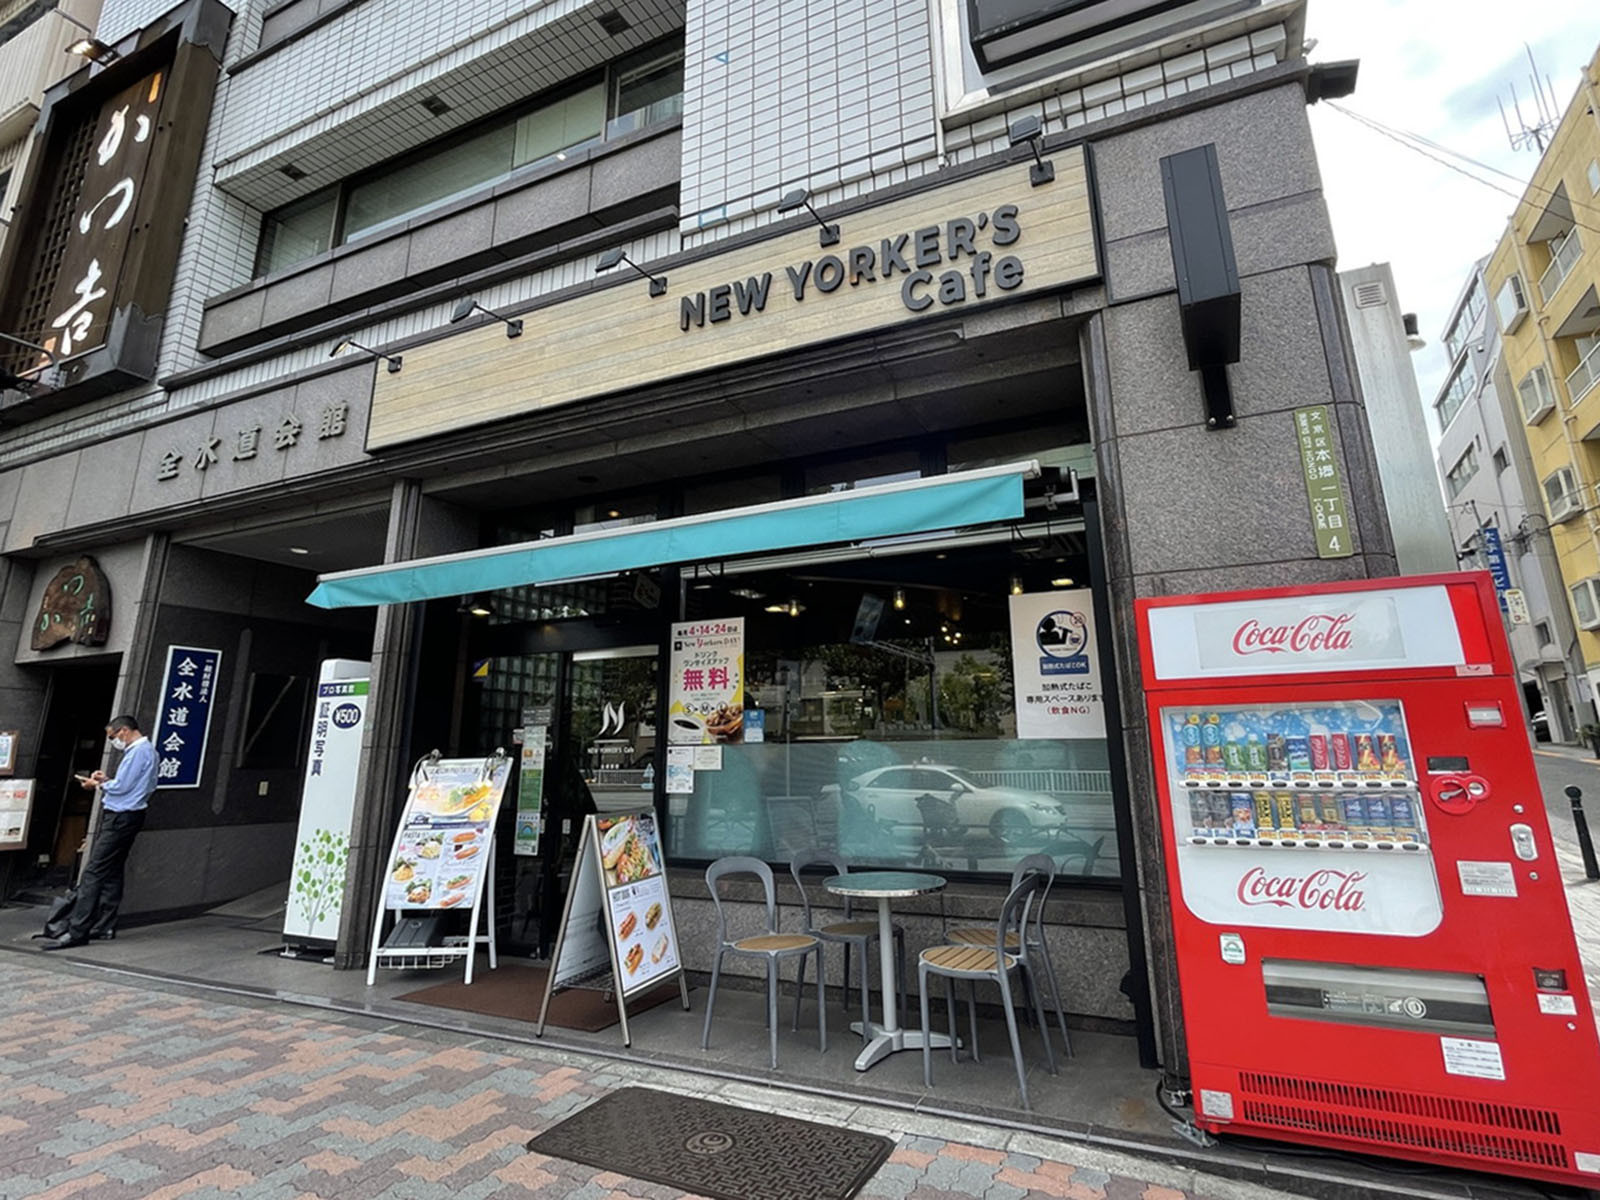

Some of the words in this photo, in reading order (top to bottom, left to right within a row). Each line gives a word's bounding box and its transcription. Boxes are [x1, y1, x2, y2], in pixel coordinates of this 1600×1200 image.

[52, 103, 150, 356] かつ吉
[680, 271, 772, 331] NEW
[786, 204, 1021, 300] YORKER'S
[901, 252, 1024, 311] Cafe
[158, 400, 349, 482] 全水道会館
[1305, 450, 1318, 480] HONGO
[1232, 613, 1356, 656] Coca-Cola
[683, 666, 729, 691] 無料
[157, 656, 198, 778] 全水道会館
[1237, 867, 1367, 913] Coca-Cola
